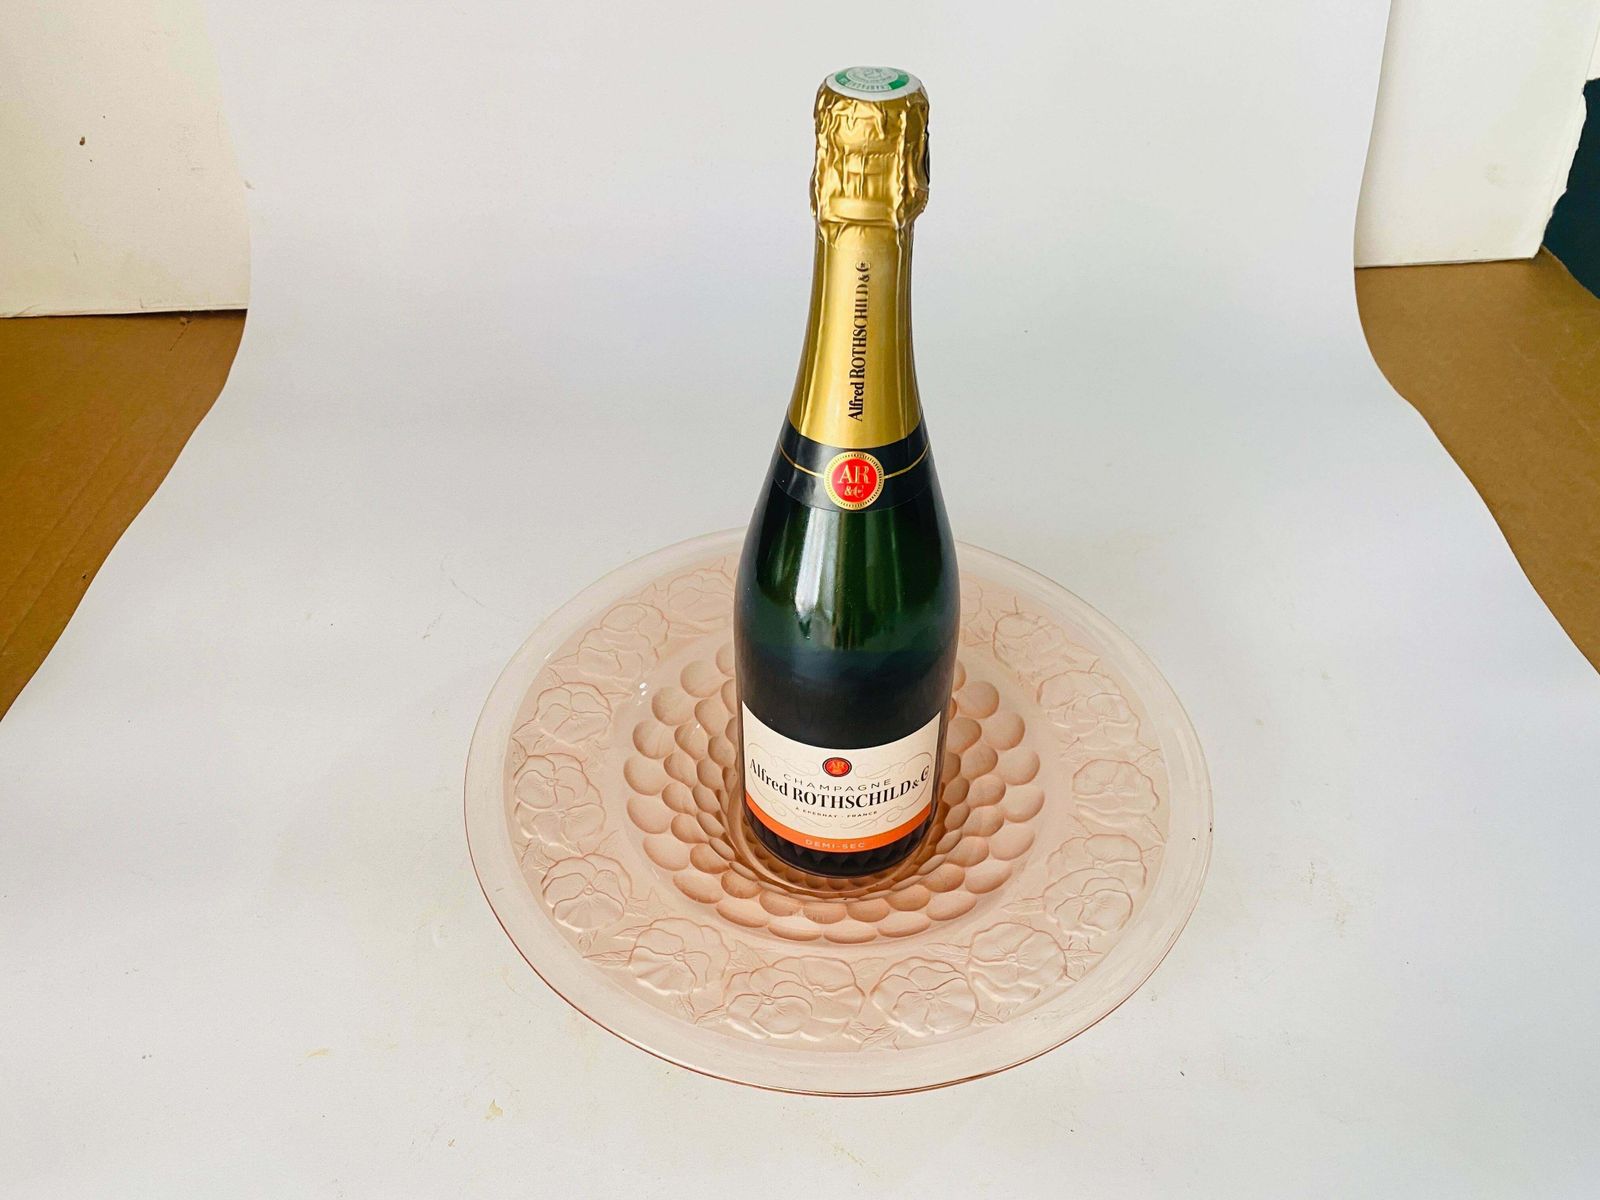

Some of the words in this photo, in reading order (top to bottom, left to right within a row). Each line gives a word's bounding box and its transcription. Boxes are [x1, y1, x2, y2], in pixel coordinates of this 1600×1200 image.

[849, 283, 869, 379] ROTHSCHILD
[847, 382, 865, 422] Alfred
[837, 464, 871, 484] AR
[749, 758, 788, 796] Alfred
[792, 780, 911, 809] ROTHSCHILD
[783, 773, 891, 793] CHAMPAGNE
[805, 839, 865, 850] DEMI-SEC
